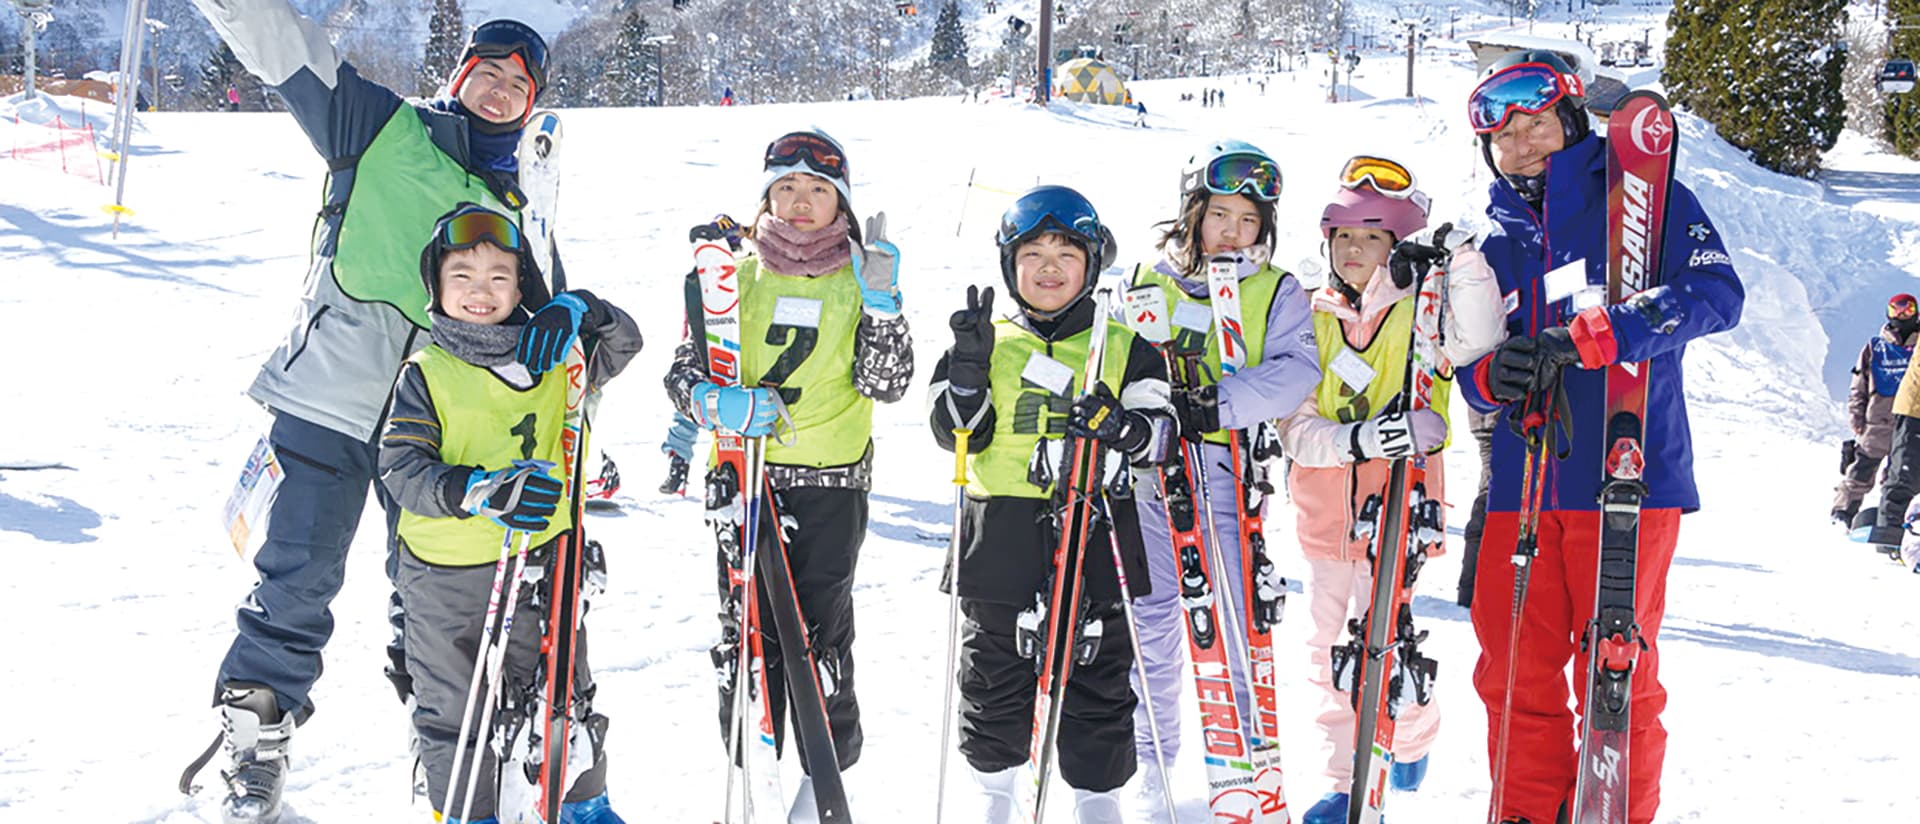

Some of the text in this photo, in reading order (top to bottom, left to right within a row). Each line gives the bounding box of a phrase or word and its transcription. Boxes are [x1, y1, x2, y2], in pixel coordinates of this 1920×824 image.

[1620, 170, 1650, 301] SAKA
[757, 322, 819, 405] 2
[510, 412, 538, 460] 1
